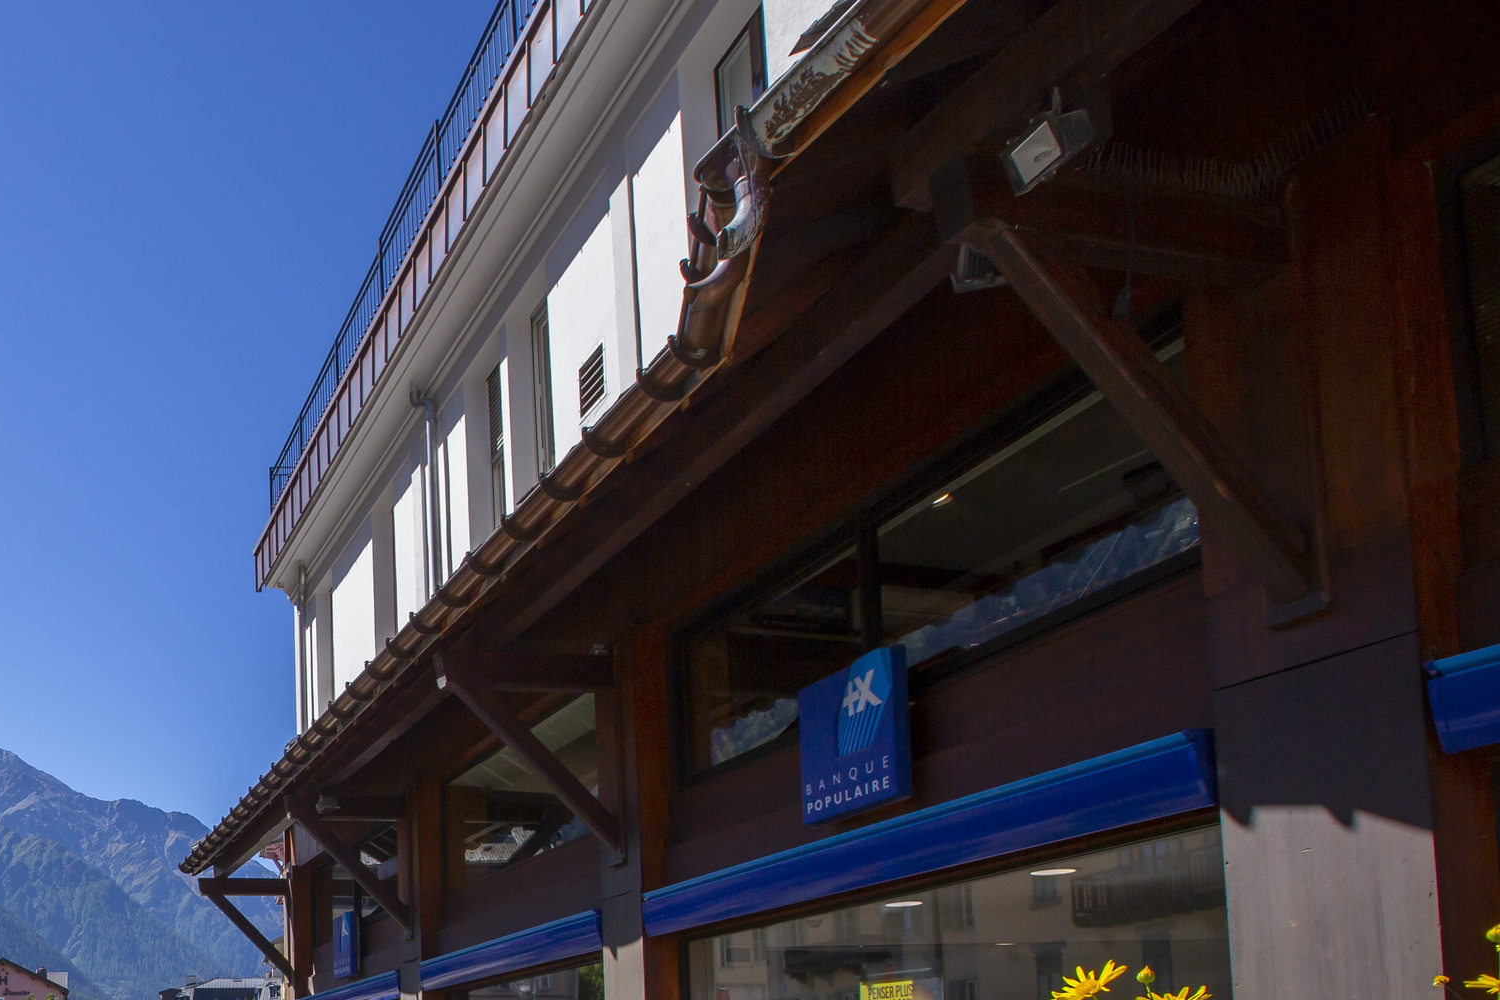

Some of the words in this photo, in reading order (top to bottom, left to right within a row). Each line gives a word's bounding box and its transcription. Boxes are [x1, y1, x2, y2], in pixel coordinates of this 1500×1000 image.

[805, 755, 890, 796] BANQUE
[806, 775, 891, 815] POPULAIRE
[868, 985, 894, 1000] PENSER
[895, 983, 914, 998] PLUS
